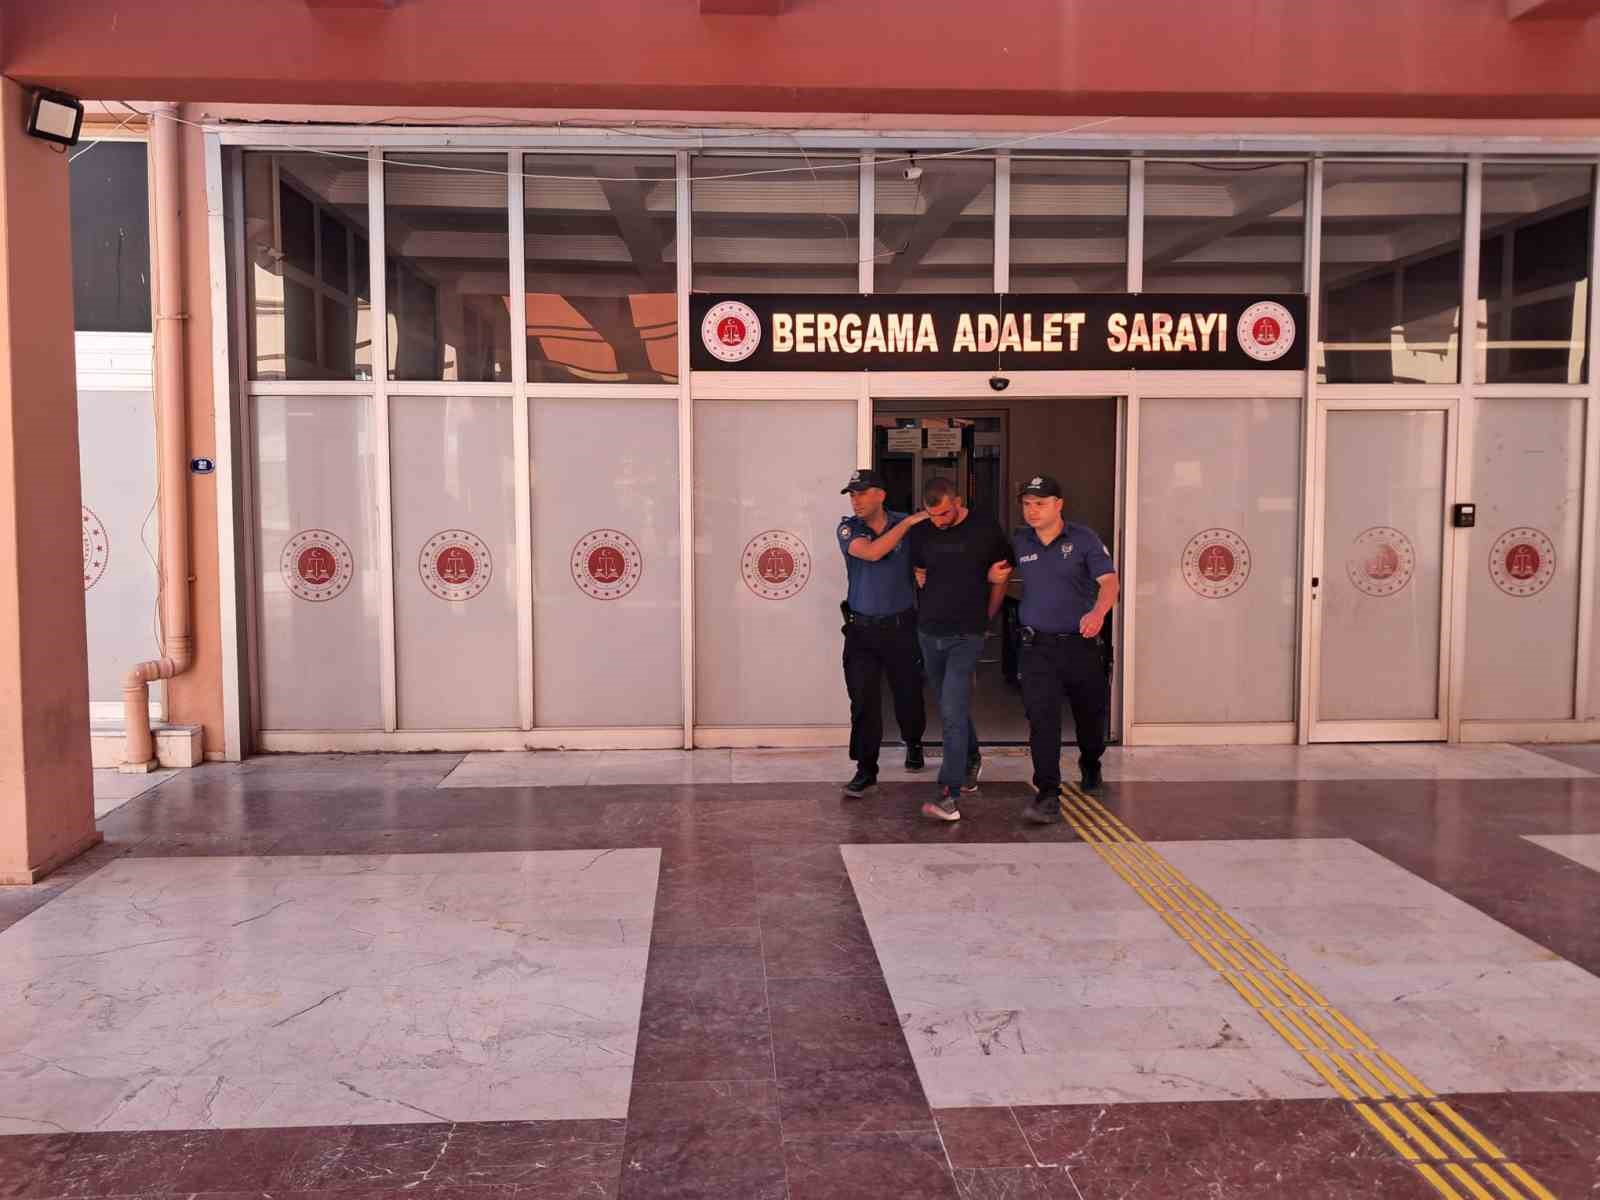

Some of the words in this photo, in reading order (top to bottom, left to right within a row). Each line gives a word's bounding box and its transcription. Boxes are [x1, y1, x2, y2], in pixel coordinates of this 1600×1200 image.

[772, 313, 939, 353] BERGAMA
[952, 312, 1086, 352] ADALET
[1106, 312, 1228, 352] SARAYI
